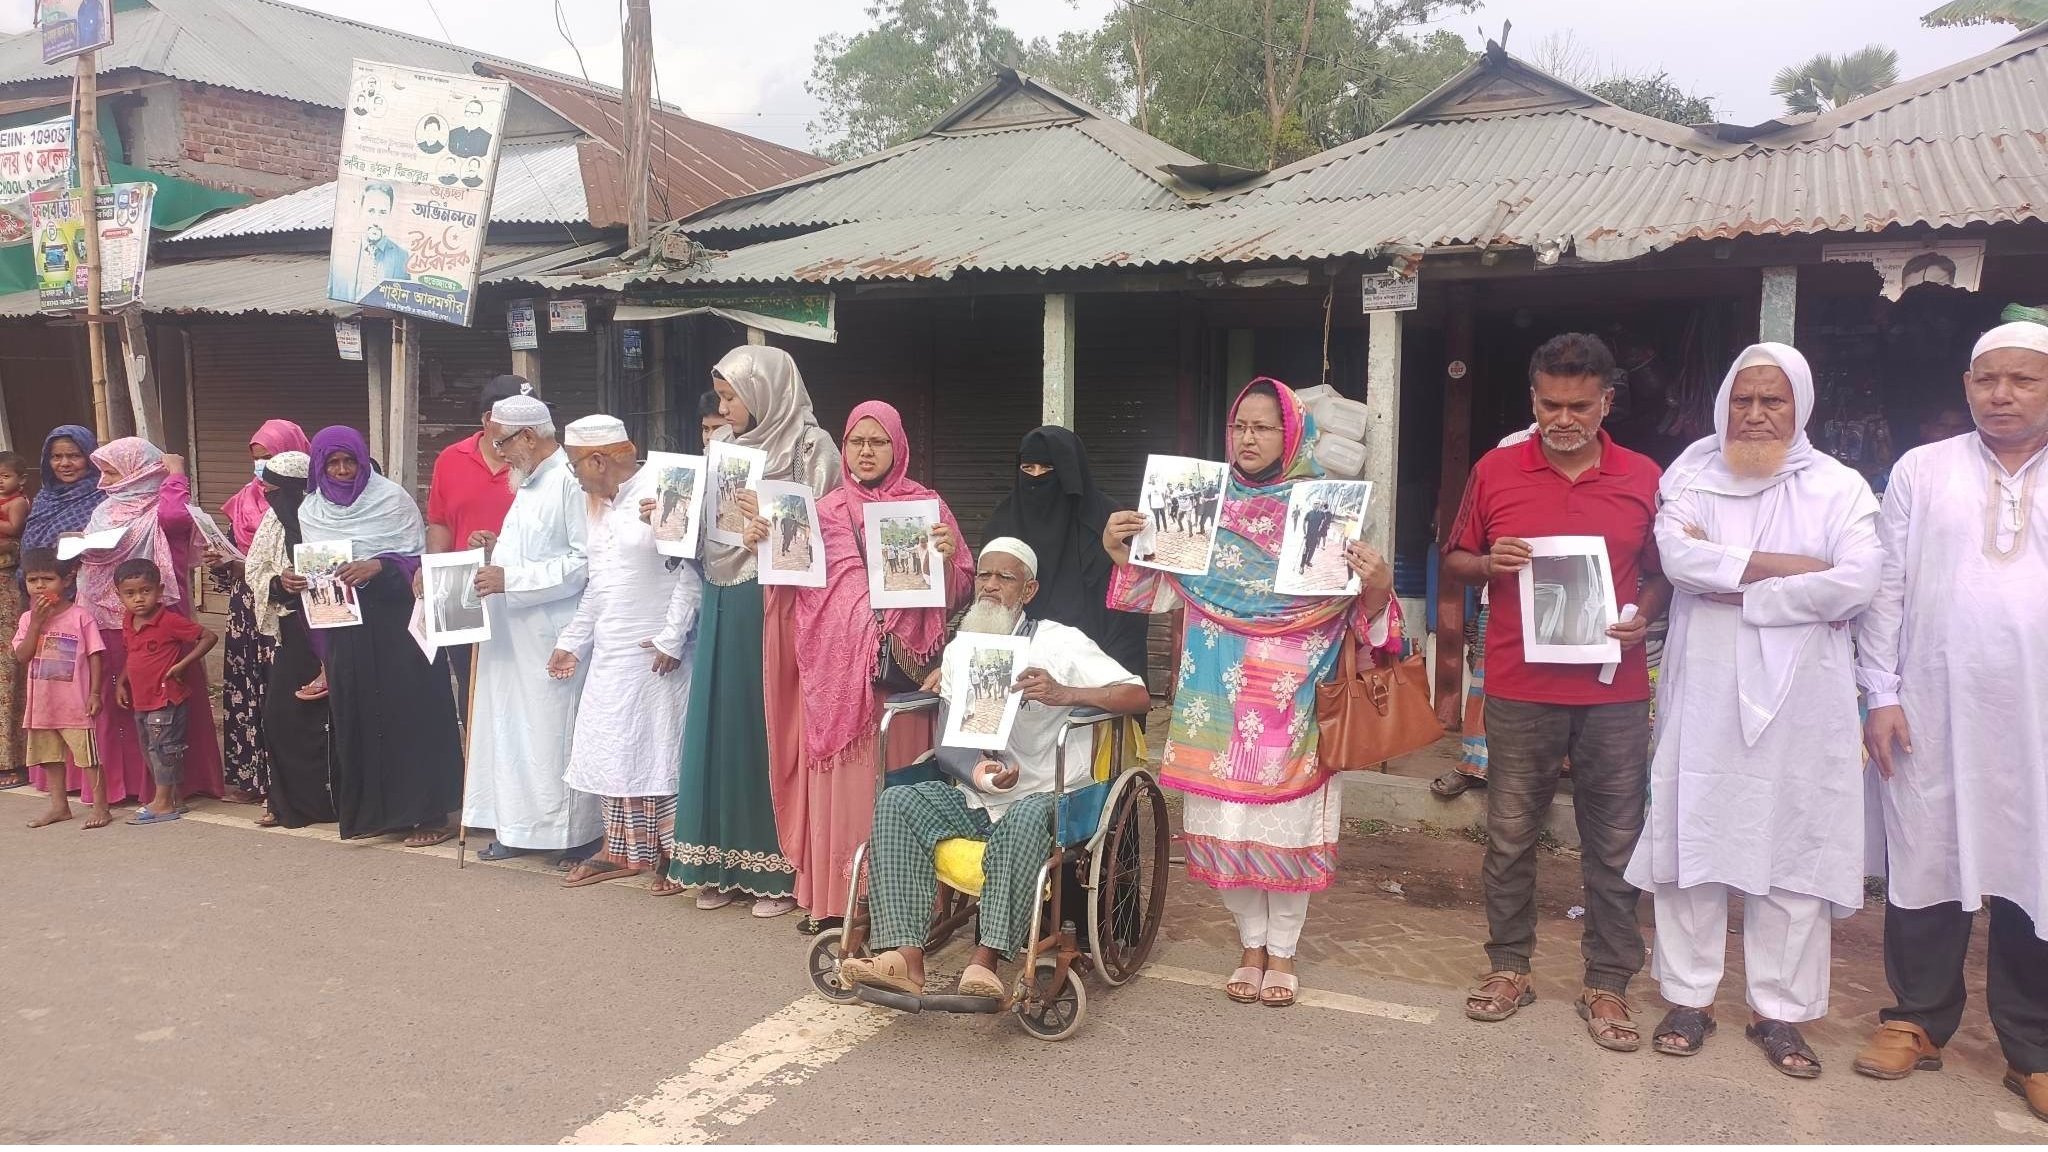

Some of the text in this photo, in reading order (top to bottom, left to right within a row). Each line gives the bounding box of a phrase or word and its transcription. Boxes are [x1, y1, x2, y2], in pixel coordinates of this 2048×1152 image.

[411, 200, 478, 228] অভিনন্দন
[406, 250, 471, 274] মোবারক
[379, 283, 466, 316] শাহীন আলমগীর
